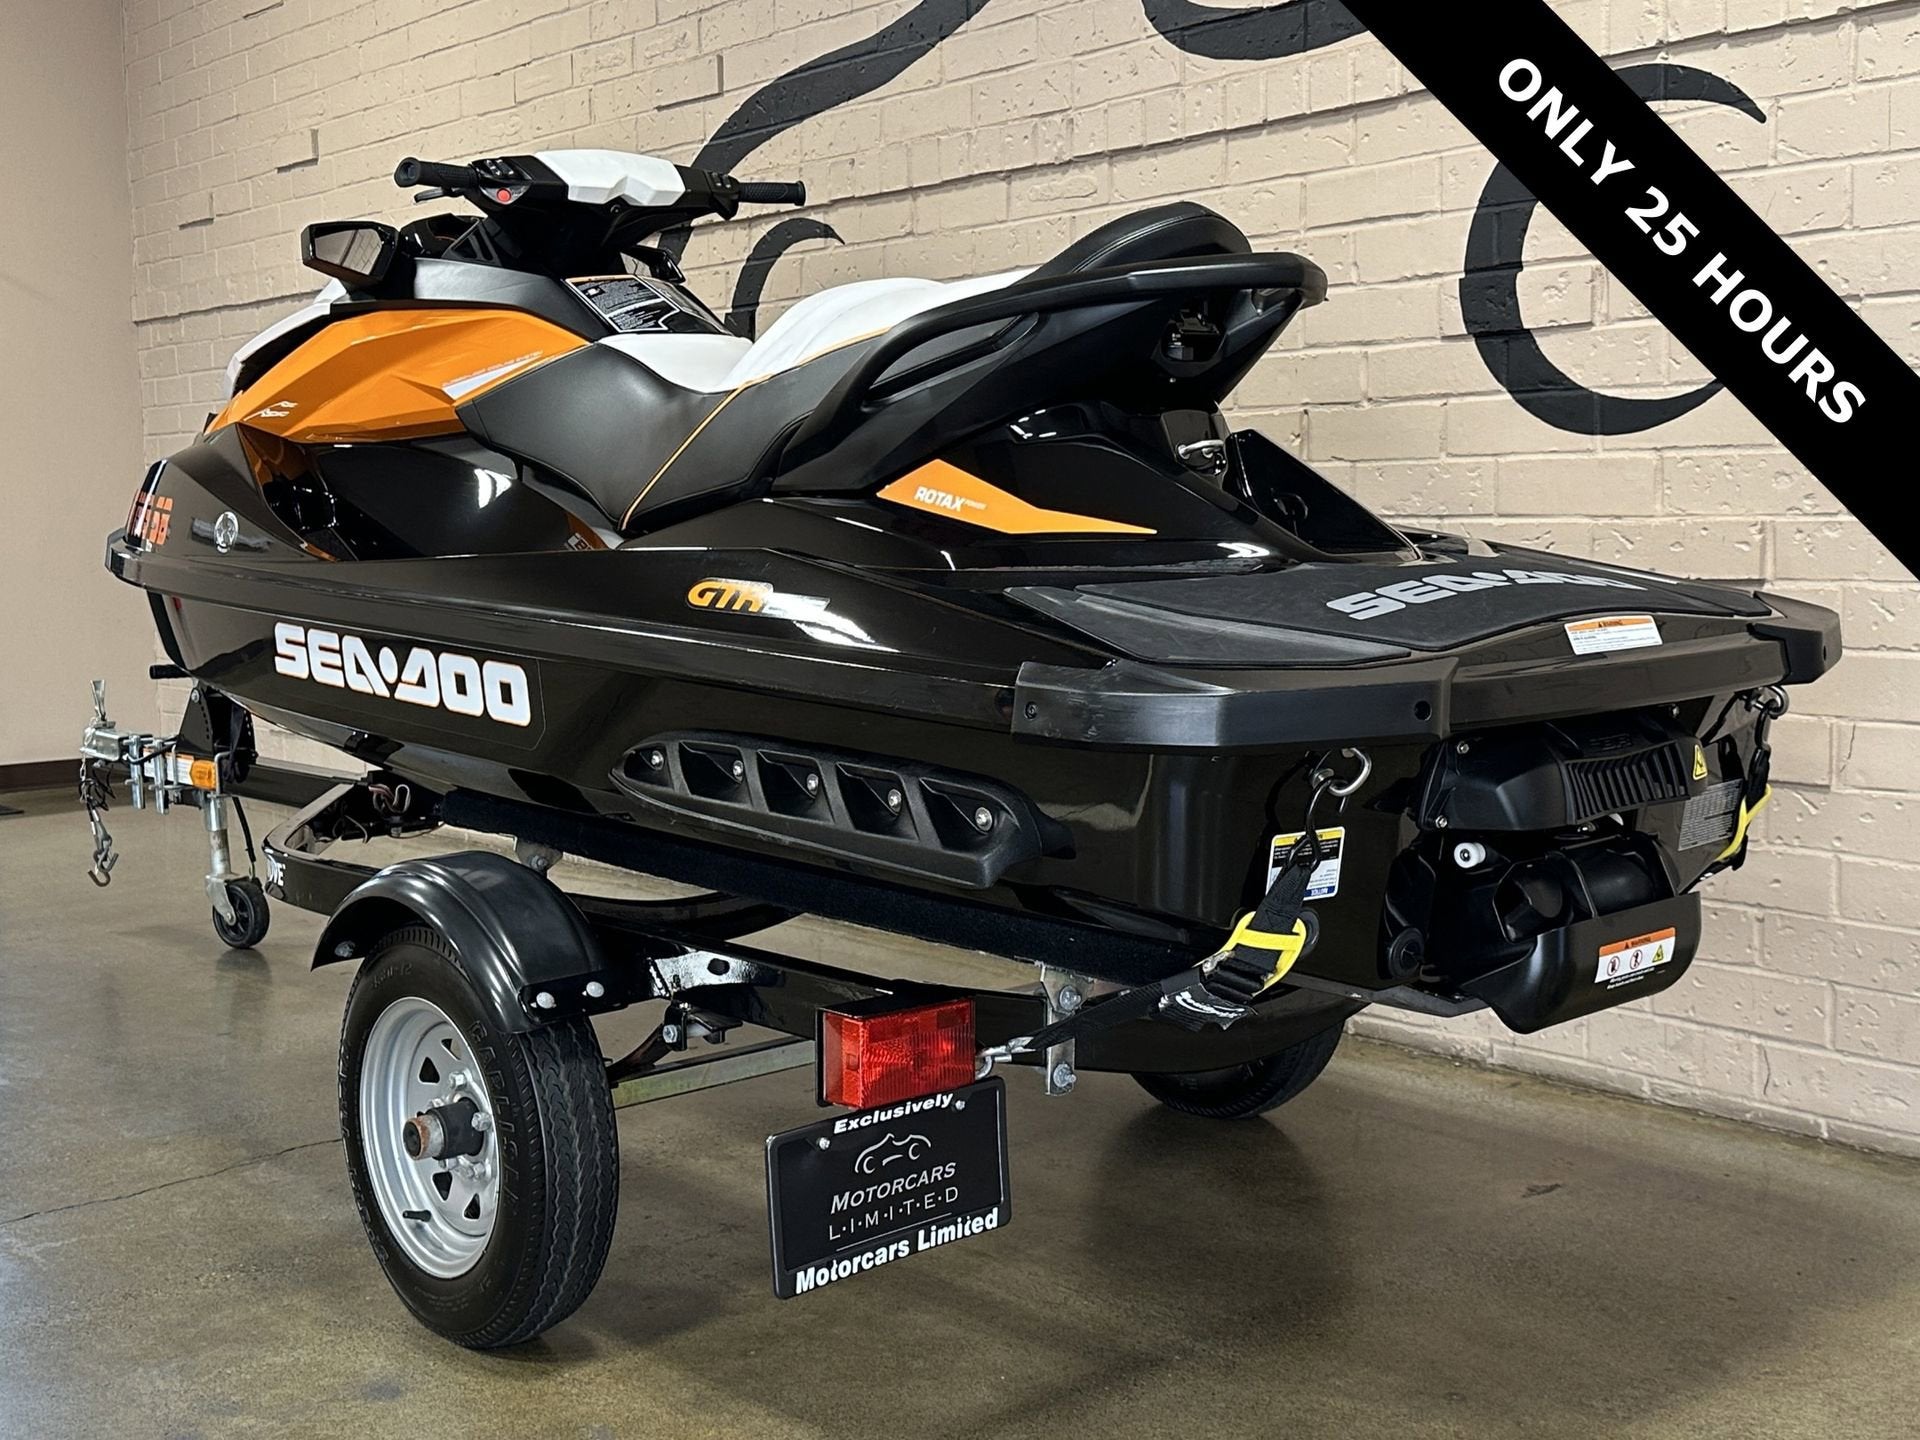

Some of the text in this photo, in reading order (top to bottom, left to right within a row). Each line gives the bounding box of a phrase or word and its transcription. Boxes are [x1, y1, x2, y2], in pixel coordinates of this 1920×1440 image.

[913, 485, 965, 512] ROTAX
[833, 1092, 954, 1134] Exclusively
[830, 1162, 956, 1215] MOTORCARS
[794, 1207, 999, 1295] Motorcars Limited
